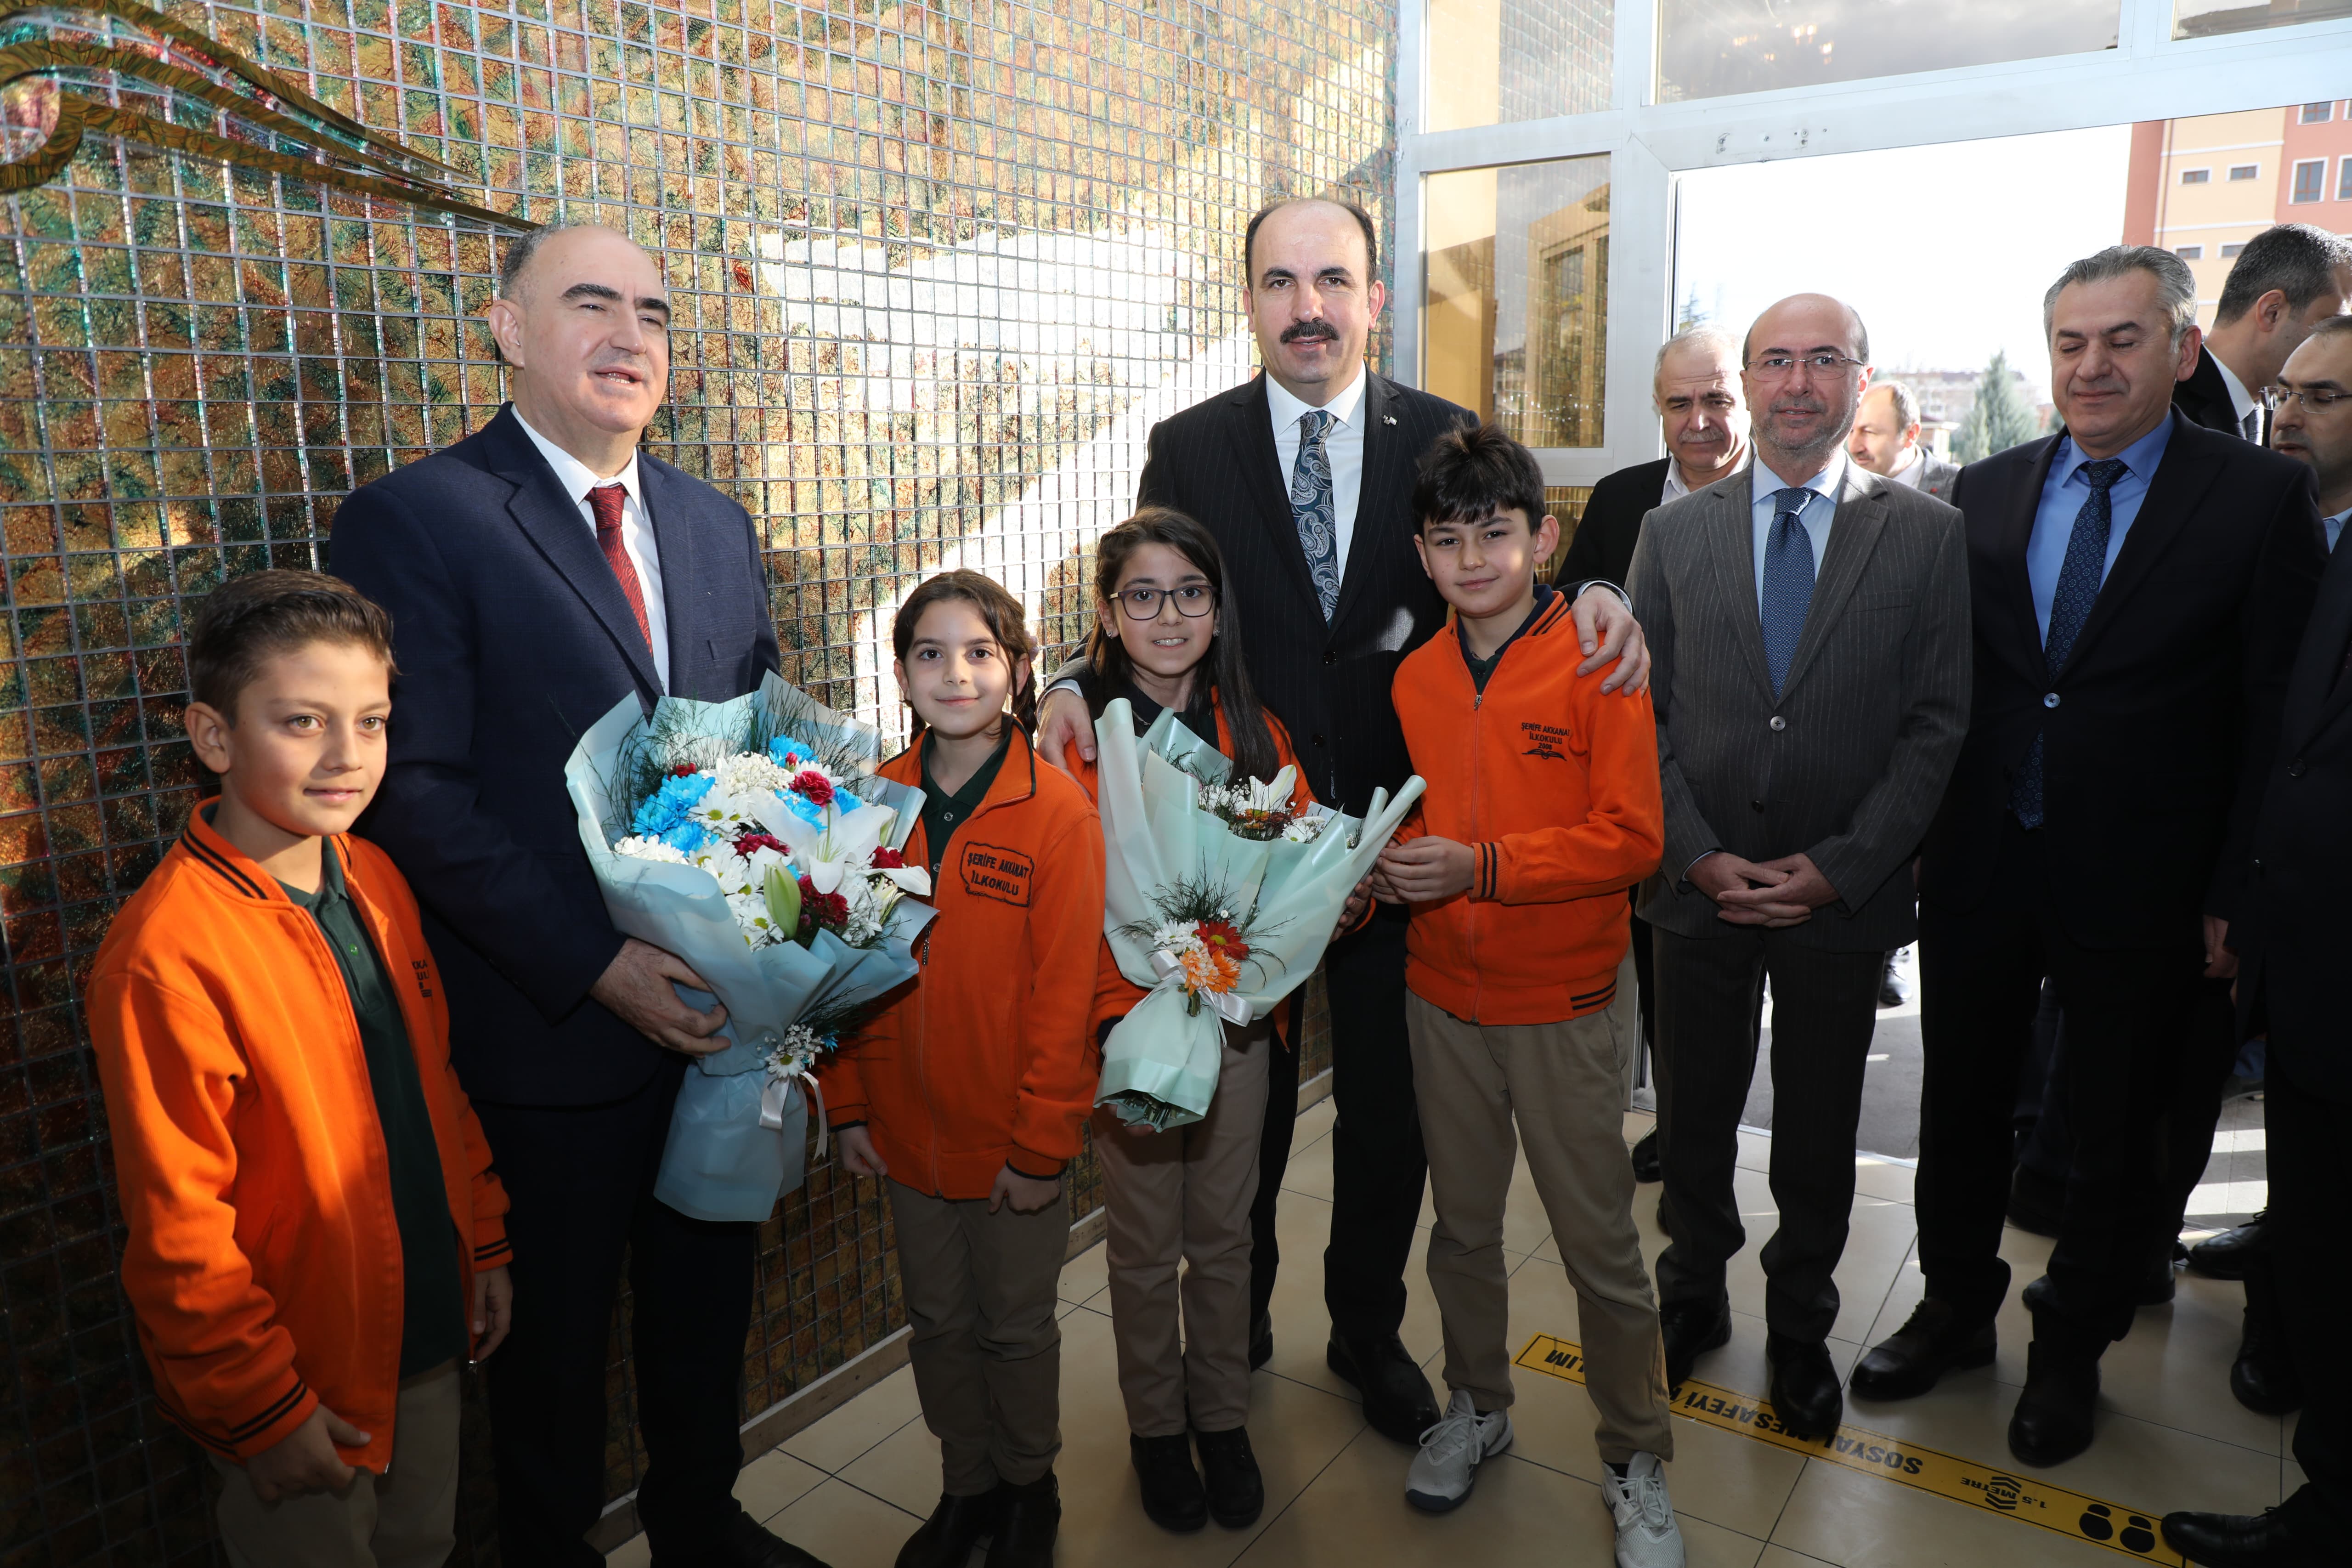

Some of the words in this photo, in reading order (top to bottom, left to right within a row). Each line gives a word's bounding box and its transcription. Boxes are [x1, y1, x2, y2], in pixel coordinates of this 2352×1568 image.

[1521, 722, 1542, 731] ŞERİFE
[1543, 726, 1570, 736] AKKANAT
[1529, 731, 1562, 744] İLKOKULU
[967, 853, 997, 869] ŞERİFE
[1960, 1477, 2017, 1500] METRE
